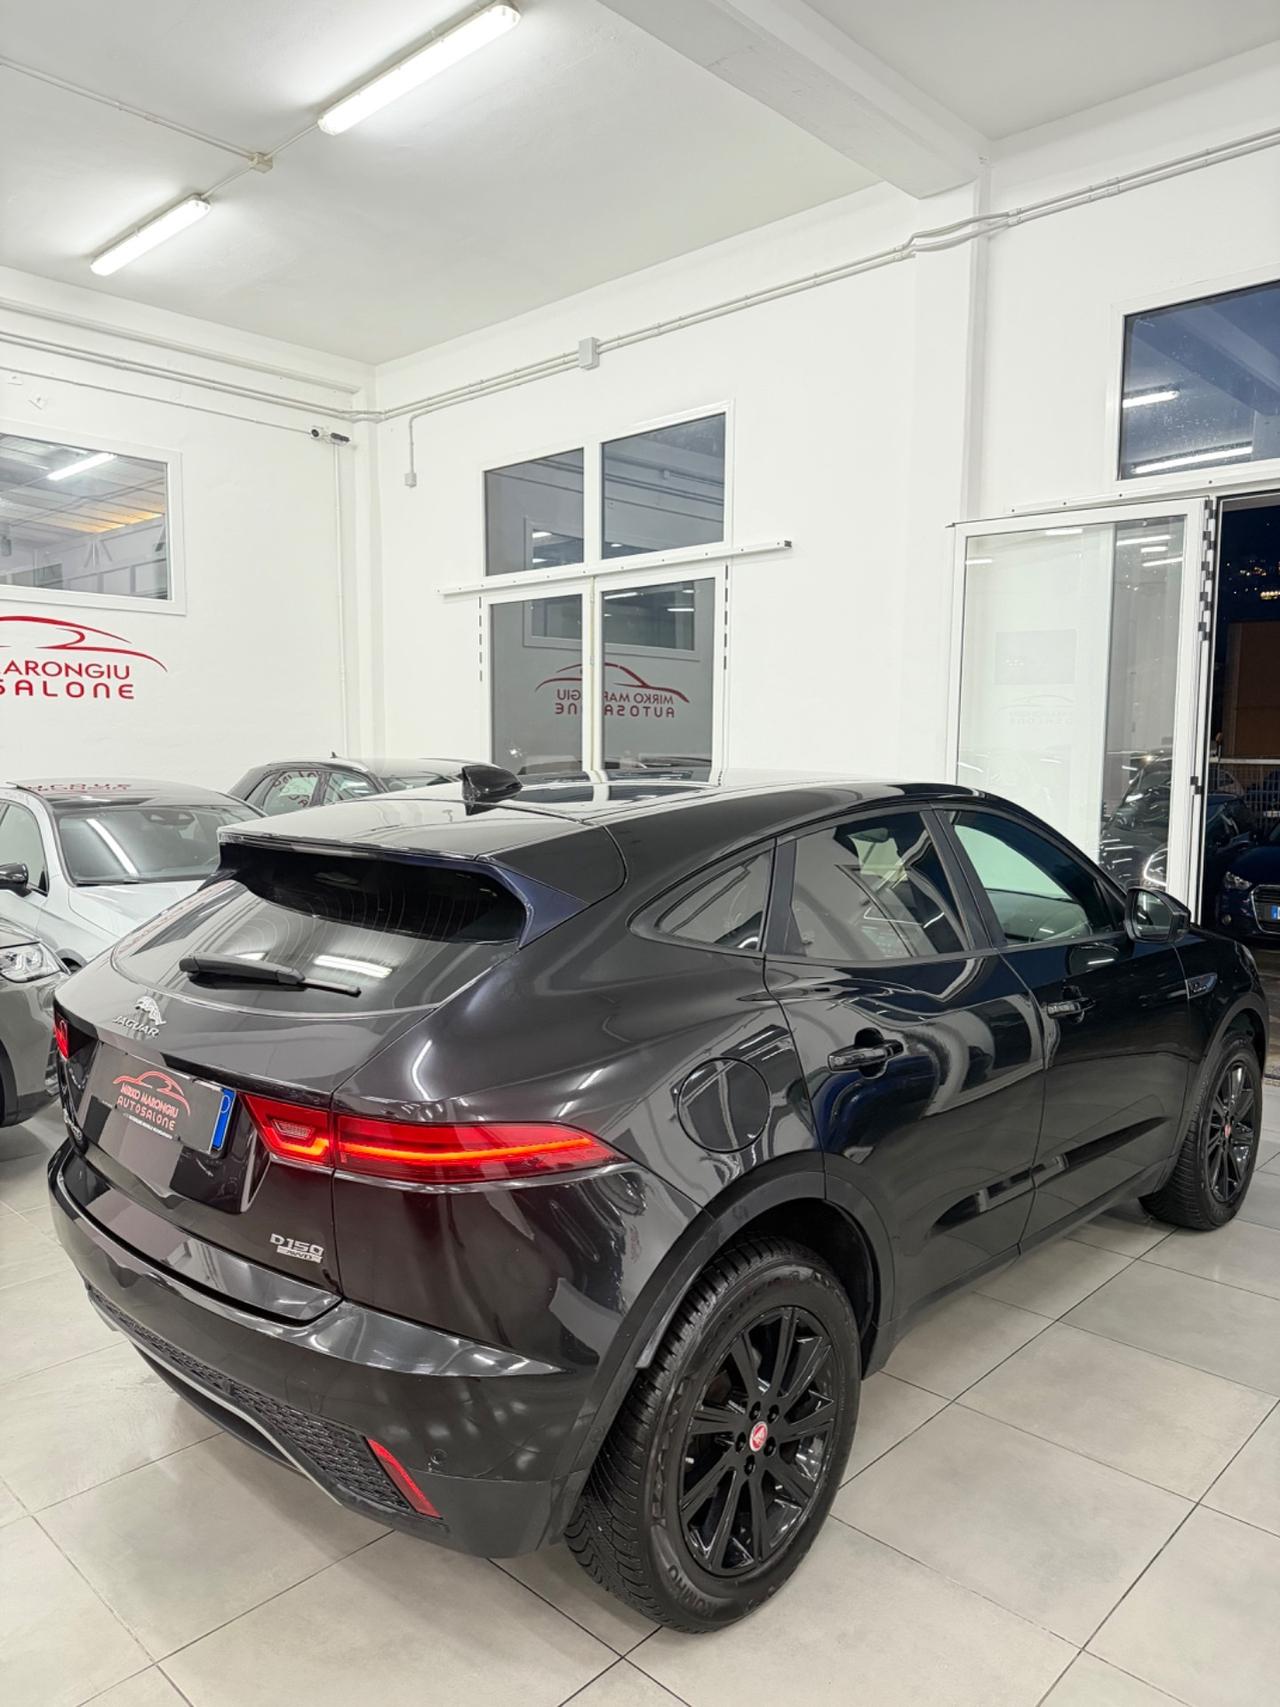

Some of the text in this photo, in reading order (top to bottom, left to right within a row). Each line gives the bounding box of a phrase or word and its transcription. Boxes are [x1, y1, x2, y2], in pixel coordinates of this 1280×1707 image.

[0, 659, 131, 680] ARONGIU
[112, 1015, 160, 1037] JAGUAR
[116, 1095, 177, 1131] AUTOSALONE
[269, 1233, 325, 1256] D150
